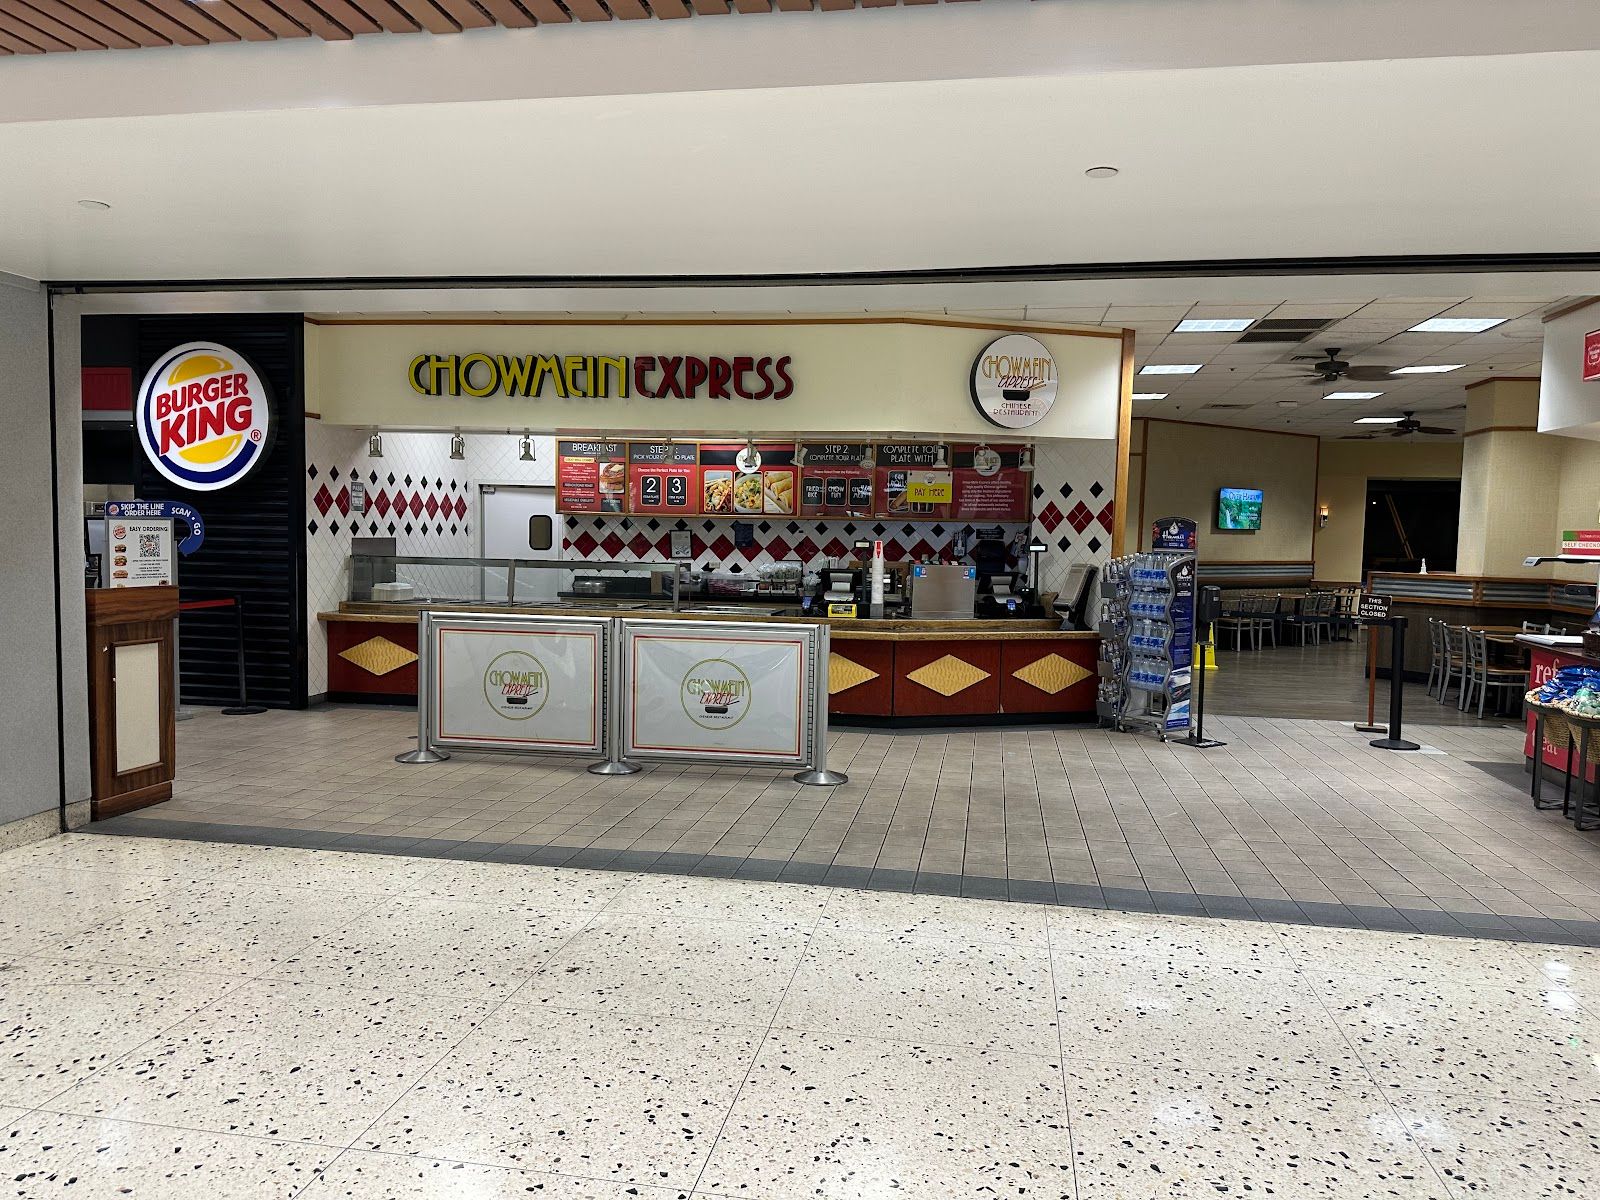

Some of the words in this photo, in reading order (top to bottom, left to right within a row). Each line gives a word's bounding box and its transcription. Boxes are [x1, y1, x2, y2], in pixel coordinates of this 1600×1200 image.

[982, 355, 1052, 381] CHOWMEIN
[408, 353, 629, 398] CHOWMEIN
[634, 355, 794, 400] EXPRESS
[156, 373, 249, 421] BURGER
[1001, 402, 1032, 410] CHINESE
[993, 409, 1038, 417] RESTAURANT
[160, 396, 253, 455] KING
[825, 445, 842, 454] STEP
[843, 445, 849, 454] 2
[883, 445, 919, 454] COMPLETE
[890, 454, 911, 462] PLATE
[914, 454, 934, 462] WITH
[646, 478, 656, 493] 2
[671, 478, 682, 494] 3
[914, 488, 926, 497] PAY
[928, 488, 945, 497] HERE
[171, 507, 192, 518] SCAN
[193, 522, 202, 536] GO
[1360, 603, 1388, 612] SECTION
[1360, 609, 1387, 618] CLOSED
